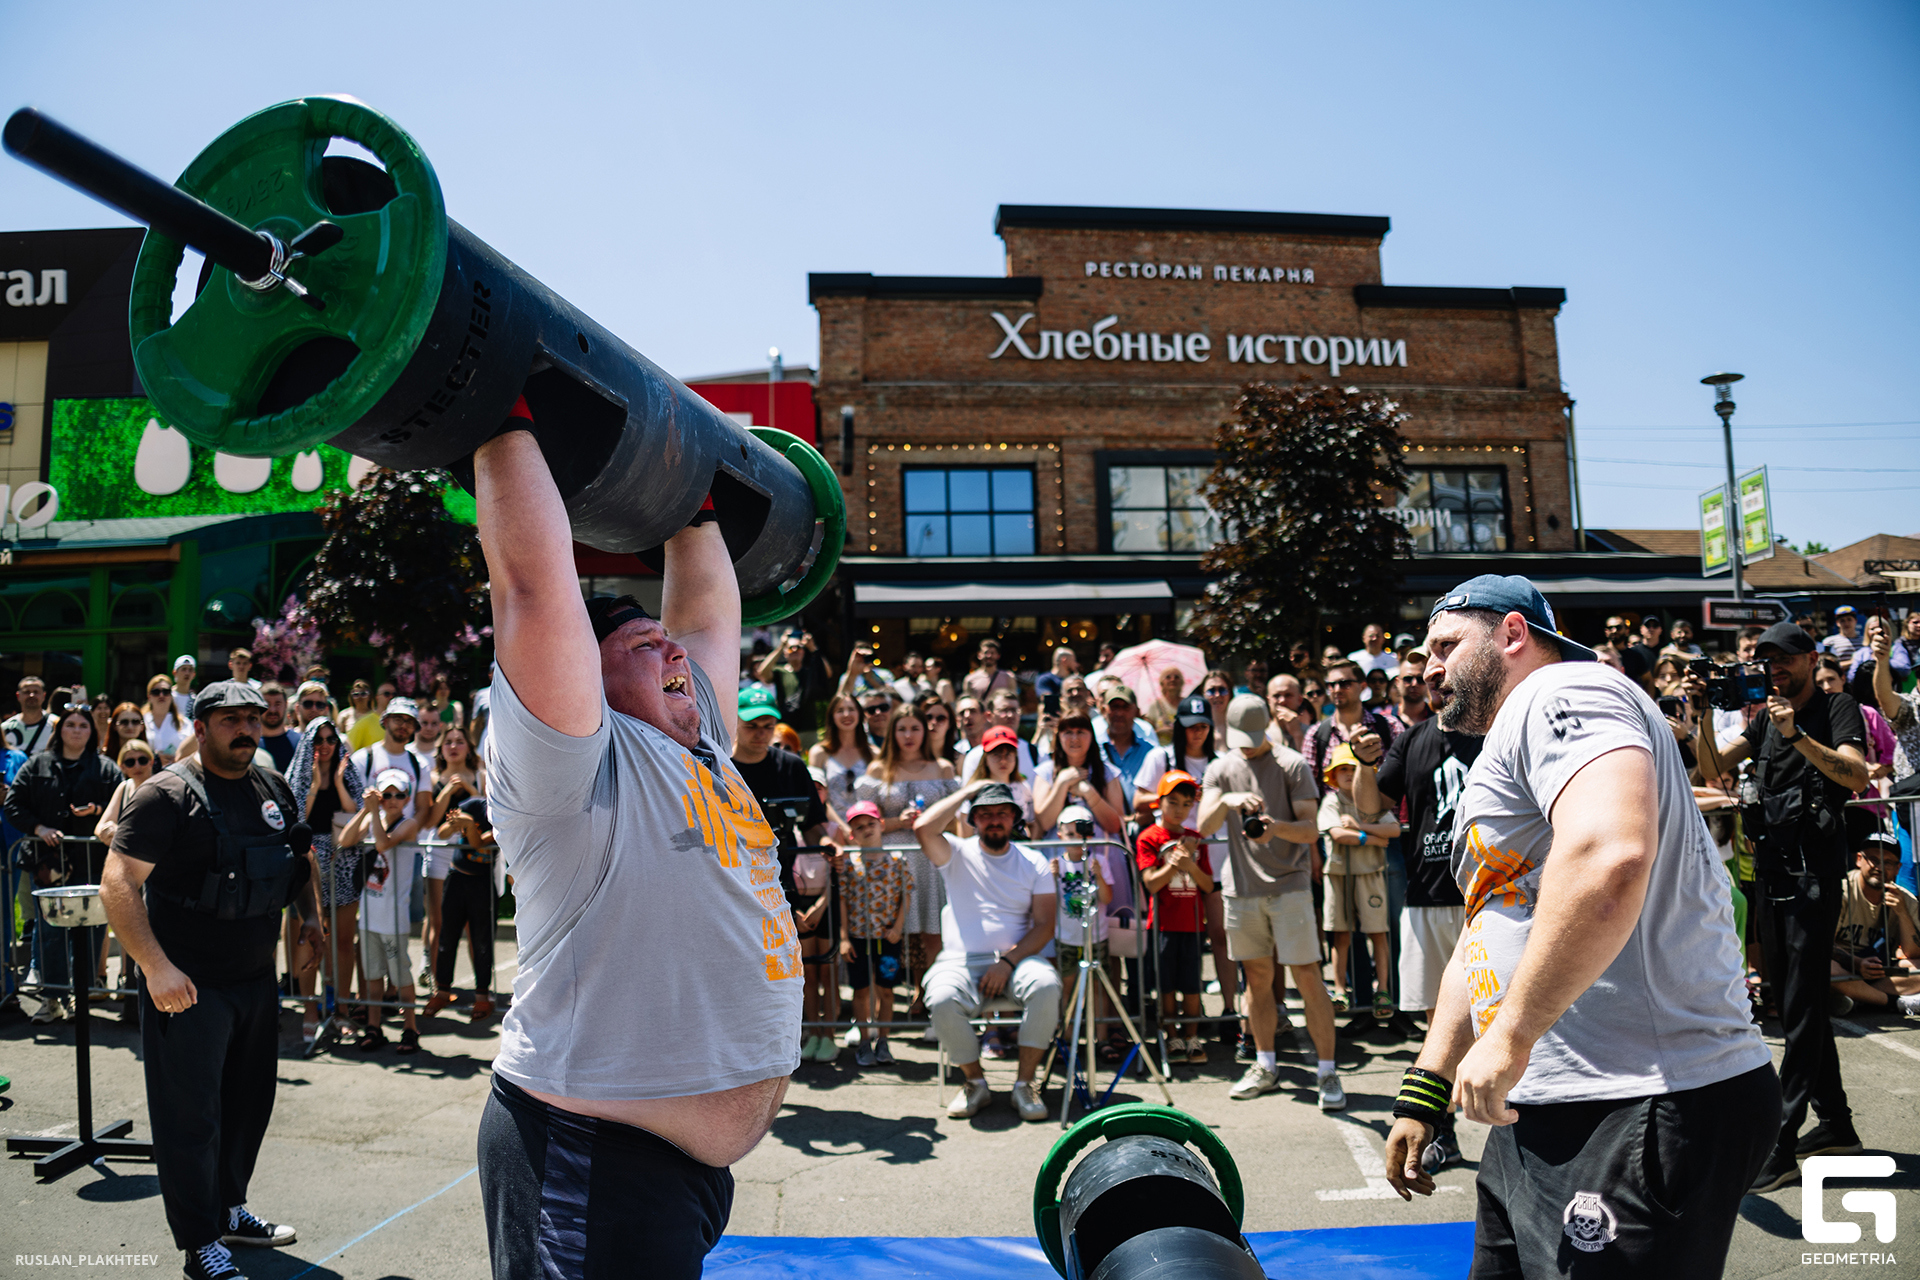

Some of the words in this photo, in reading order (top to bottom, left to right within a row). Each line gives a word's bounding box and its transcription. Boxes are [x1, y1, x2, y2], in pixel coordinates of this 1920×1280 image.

[1085, 261, 1202, 280] РЕСТОРАН
[1213, 264, 1315, 285] ПЕКАРНЯ
[988, 312, 1211, 362] Хлебные
[1227, 333, 1408, 377] истории
[1423, 842, 1448, 857] GATE
